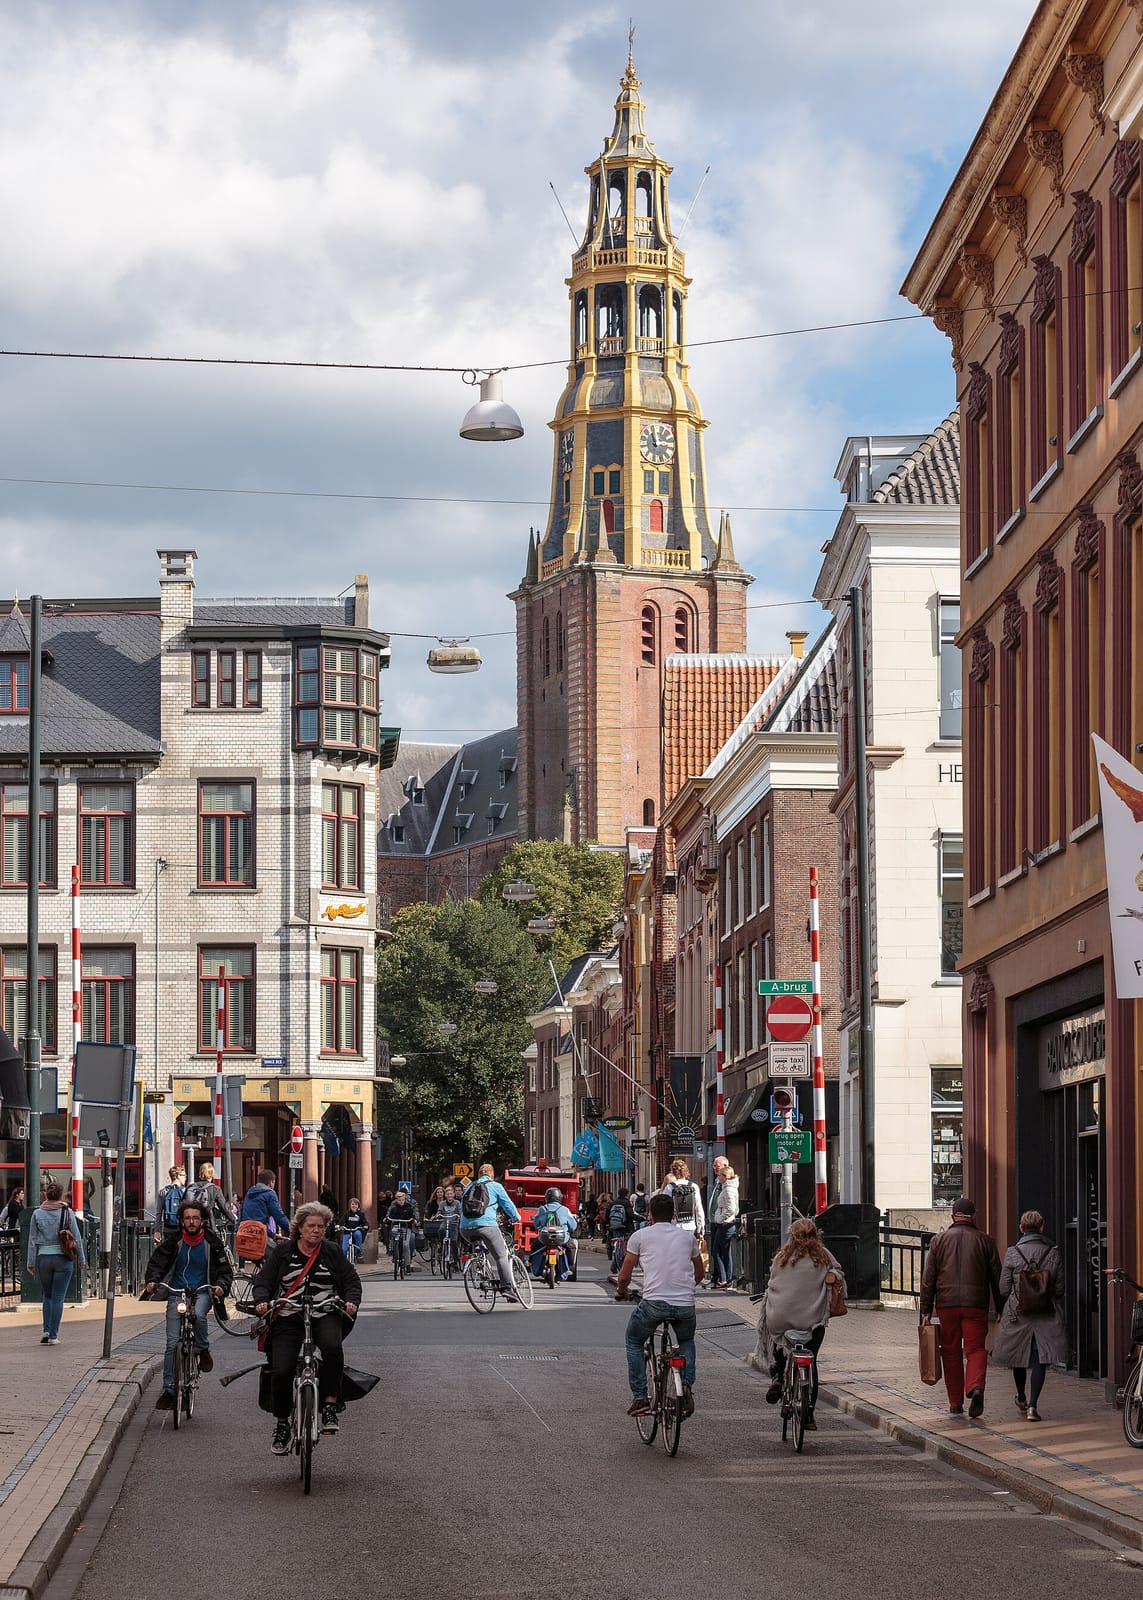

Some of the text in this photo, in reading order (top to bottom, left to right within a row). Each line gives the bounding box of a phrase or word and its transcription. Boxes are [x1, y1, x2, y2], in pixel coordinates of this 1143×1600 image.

[938, 764, 963, 783] HE
[1134, 959, 1143, 976] F
[771, 982, 807, 992] A-brug
[951, 1079, 963, 1087] Ka
